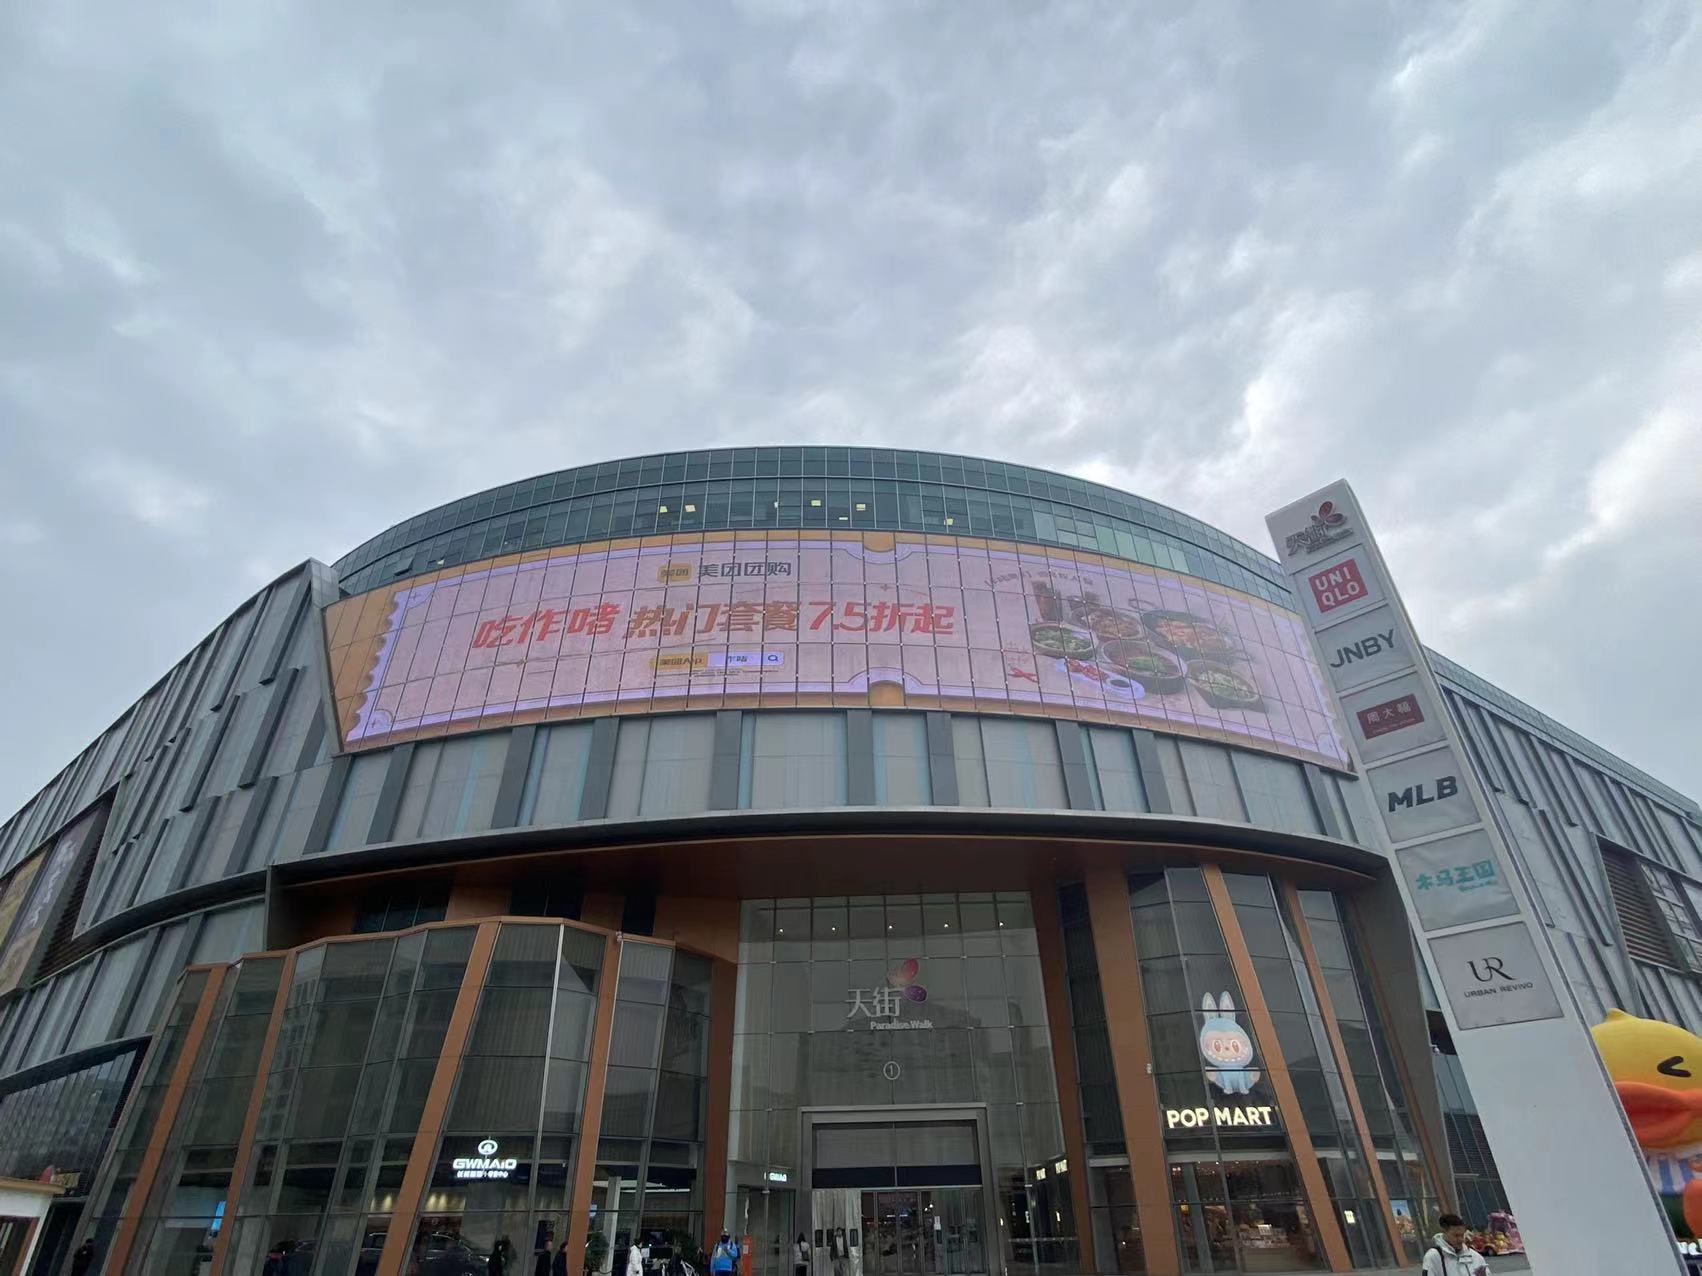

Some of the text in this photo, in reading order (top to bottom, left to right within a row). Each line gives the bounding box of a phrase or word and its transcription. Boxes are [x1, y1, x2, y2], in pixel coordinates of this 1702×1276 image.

[699, 562, 792, 577] 美团团购
[1315, 566, 1352, 590] UNI
[1322, 581, 1360, 606] QLO
[1330, 628, 1394, 668] JNBY
[1388, 776, 1459, 812] MLB
[1415, 860, 1495, 891] 木马王国
[1466, 957, 1518, 982] UR
[845, 986, 904, 1018] 天街
[1463, 987, 1497, 998] URBAN
[870, 1018, 934, 1030] Paradise Walk
[1166, 1106, 1272, 1129] POP MART
